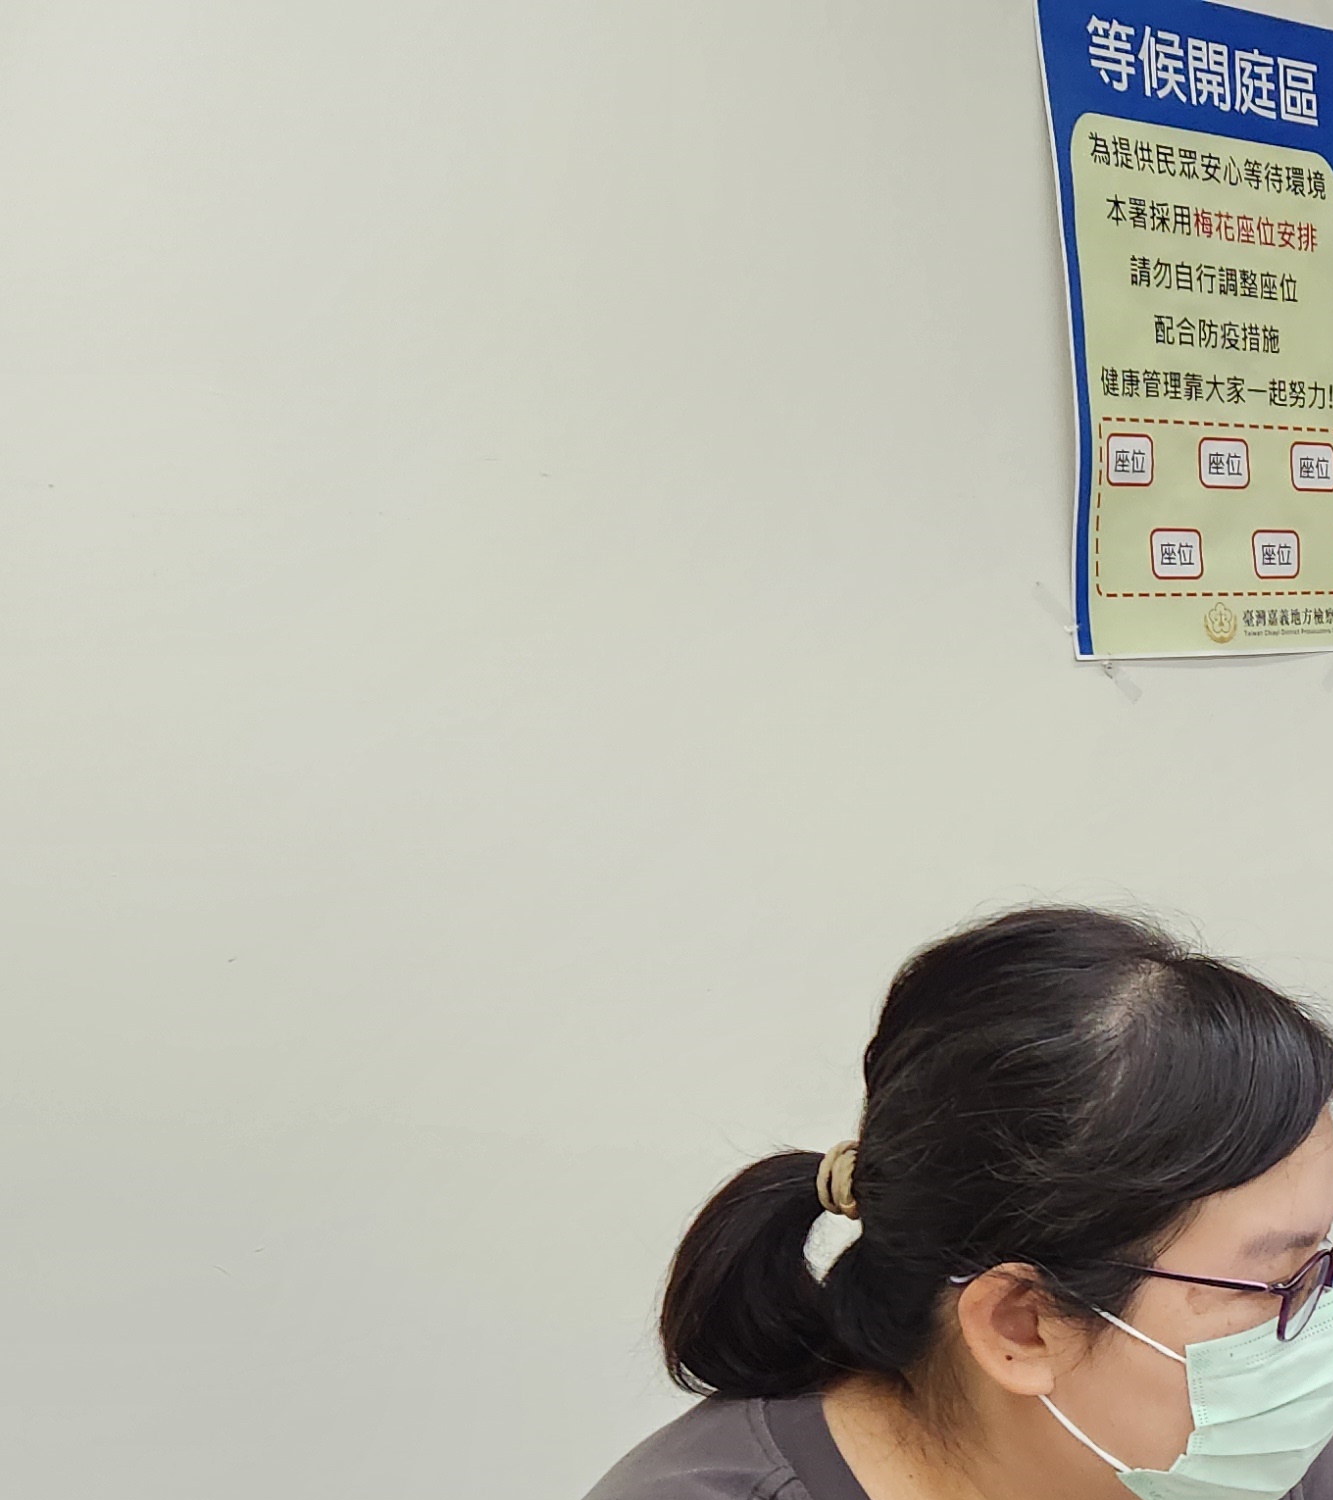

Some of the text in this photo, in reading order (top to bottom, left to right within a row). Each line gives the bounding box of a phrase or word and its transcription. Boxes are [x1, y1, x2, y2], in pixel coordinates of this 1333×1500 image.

[1086, 15, 1319, 126] 等候開庭區
[1088, 131, 1327, 200] 為提供民眾安心等待環境
[1105, 194, 1318, 253] 本署採用梅花座位安排
[1130, 255, 1299, 303] 請勿自行調整座位
[1154, 315, 1280, 354] 配合防疫措施
[1100, 366, 1333, 410] 健康管理靠大家一起努力!
[1114, 449, 1146, 474] 座位
[1208, 452, 1243, 477] 座位
[1299, 456, 1330, 480] 座位
[1160, 543, 1195, 566] 座位
[1261, 543, 1292, 567] 座位
